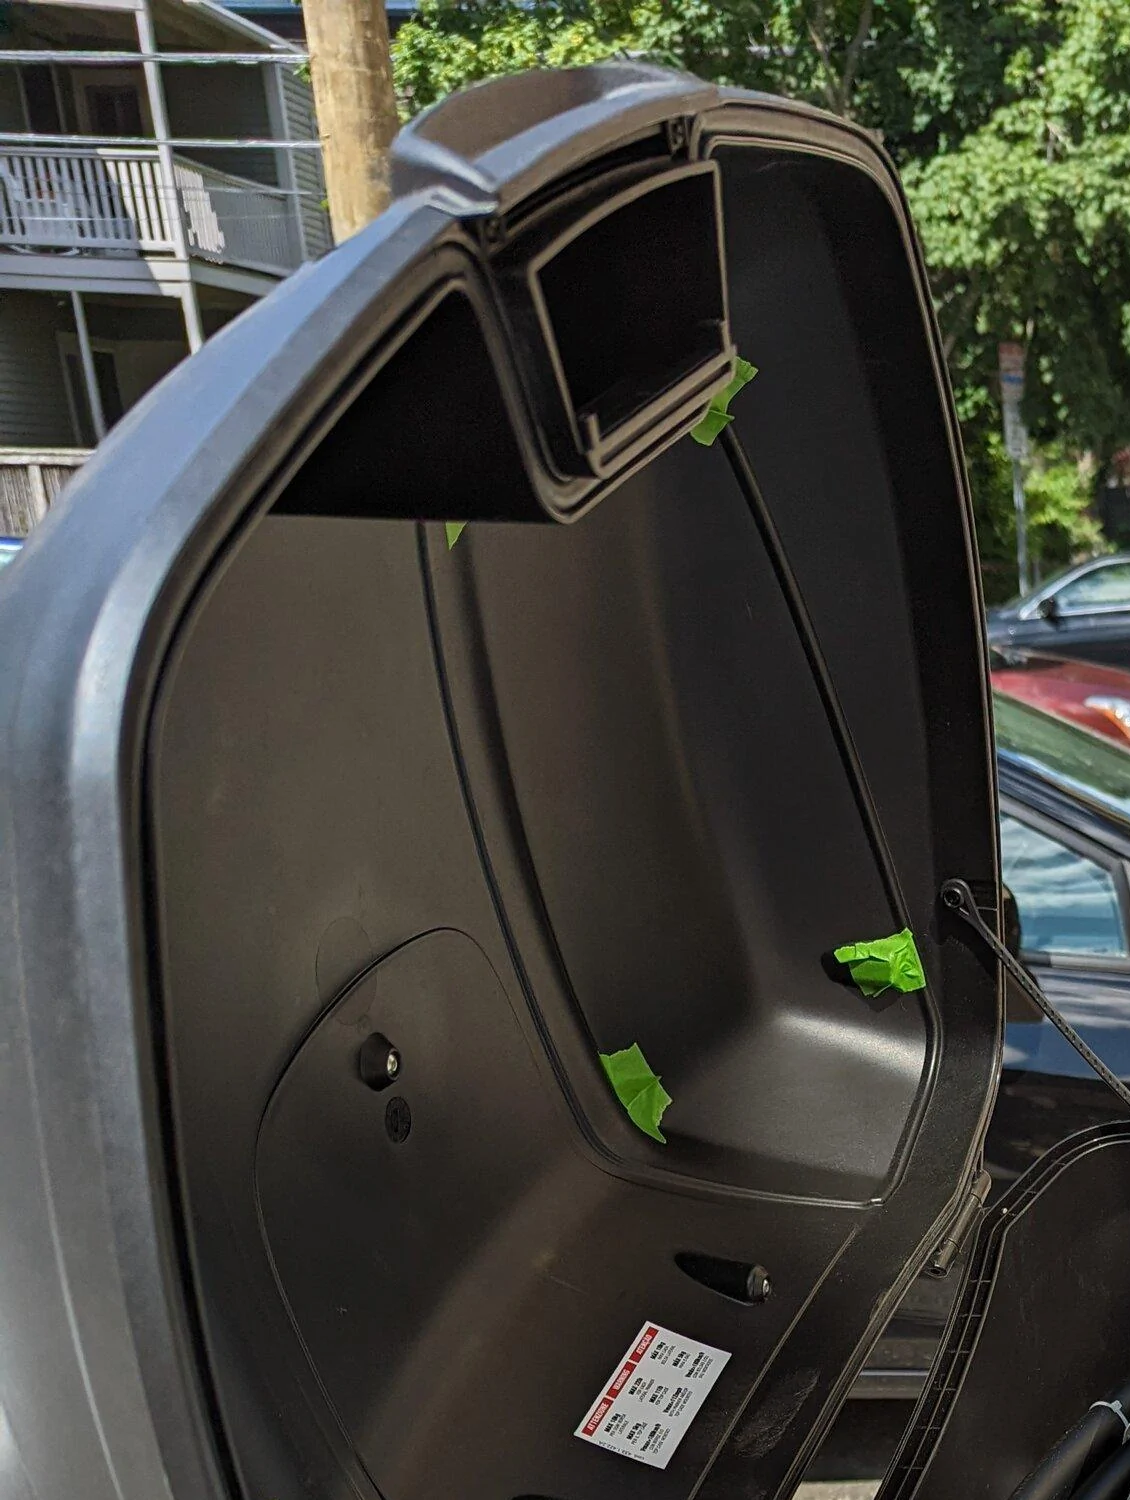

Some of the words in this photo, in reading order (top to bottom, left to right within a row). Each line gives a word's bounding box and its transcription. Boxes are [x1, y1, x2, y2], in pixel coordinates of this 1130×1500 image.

[628, 1386, 638, 1395] MAX
[649, 1394, 658, 1403] MAX
[604, 1423, 614, 1433] MAX
